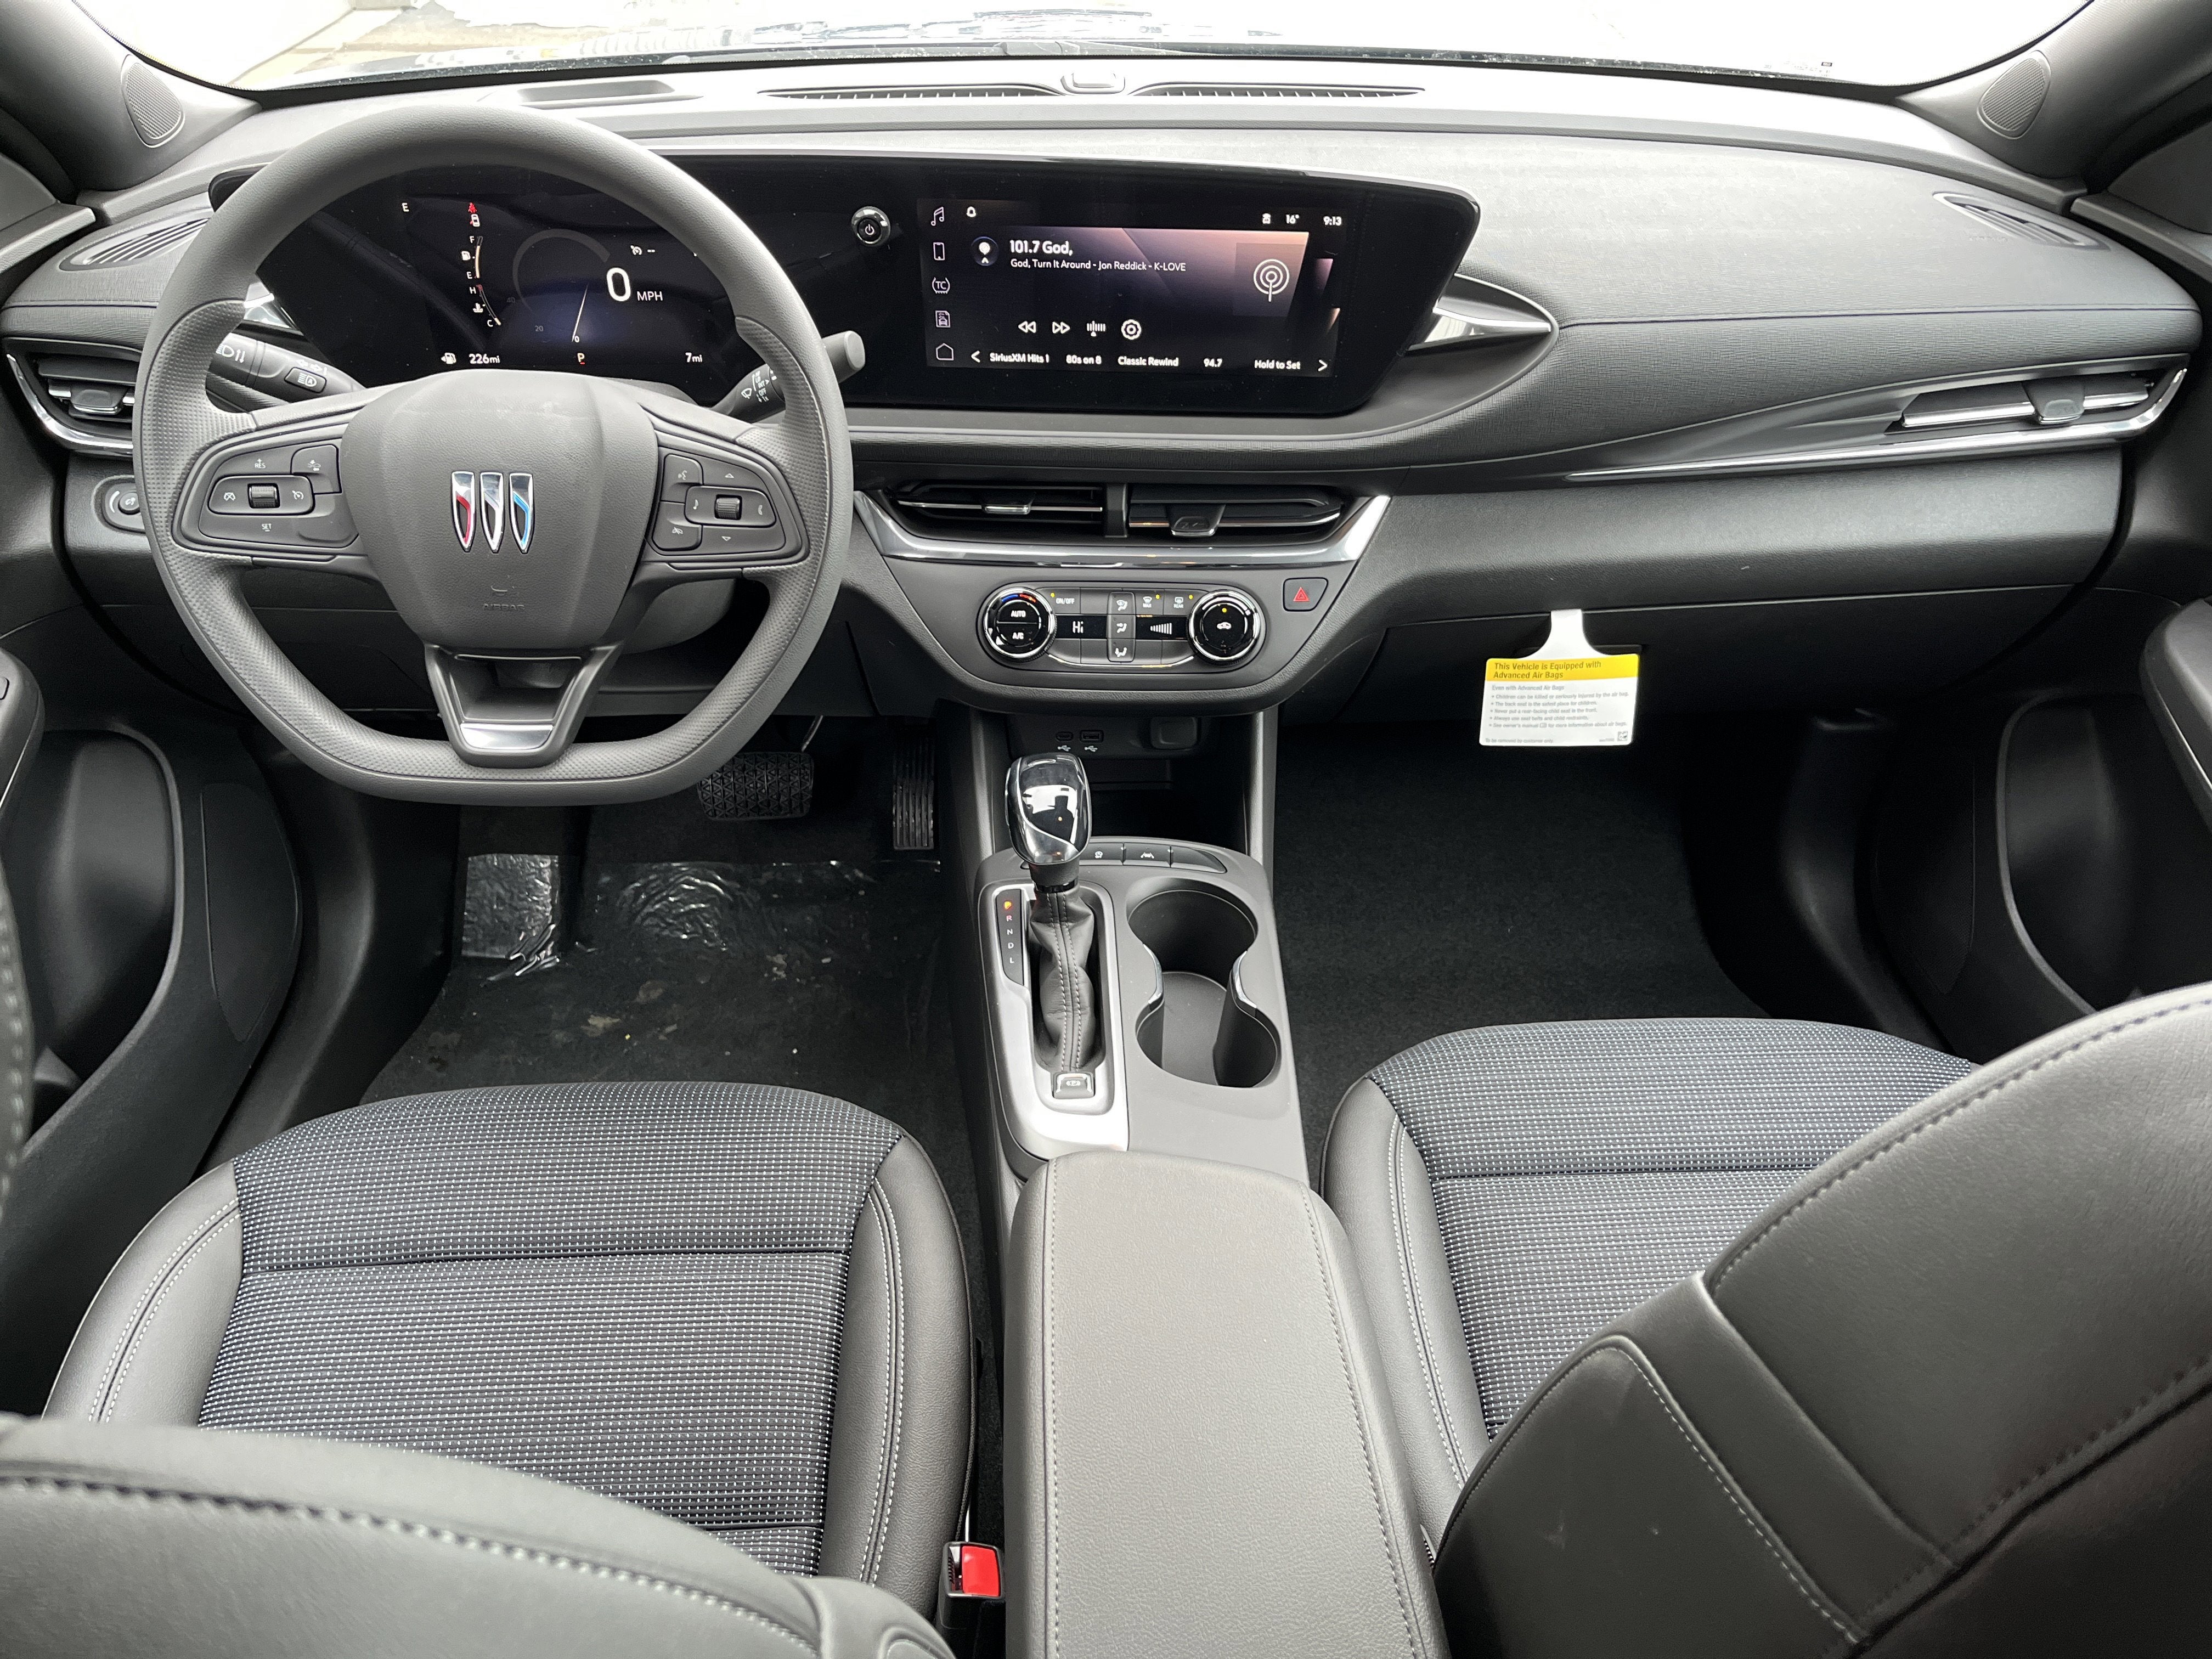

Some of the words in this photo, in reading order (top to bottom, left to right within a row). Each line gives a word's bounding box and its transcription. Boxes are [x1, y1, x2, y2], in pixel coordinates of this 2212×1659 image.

[402, 202, 409, 212] E
[1323, 216, 1342, 226] 9:13
[1010, 240, 1040, 253] 101.7
[1042, 241, 1073, 256] God,
[1011, 259, 1031, 268] God,
[1032, 259, 1052, 268] Turn
[1053, 259, 1059, 268] It
[1061, 260, 1091, 269] Around
[1098, 261, 1112, 270] Jon
[1114, 261, 1147, 270] Reddick
[1154, 262, 1186, 272] K-LOVE
[607, 267, 631, 301] 0
[636, 291, 663, 301] MPH
[577, 353, 585, 363] P
[990, 353, 1026, 362] SiriusXM
[1028, 354, 1044, 363] Hits
[1118, 357, 1147, 366] Classic
[1148, 357, 1179, 366] Rewind
[1204, 359, 1222, 368] 94.7
[1254, 359, 1275, 369] Hold
[1276, 362, 1285, 370] to
[1286, 360, 1301, 370] Set
[1072, 621, 1084, 634] Hi
[1513, 662, 1539, 670] Vehicle
[1550, 662, 1583, 671] Equipped
[1586, 661, 1601, 669] with
